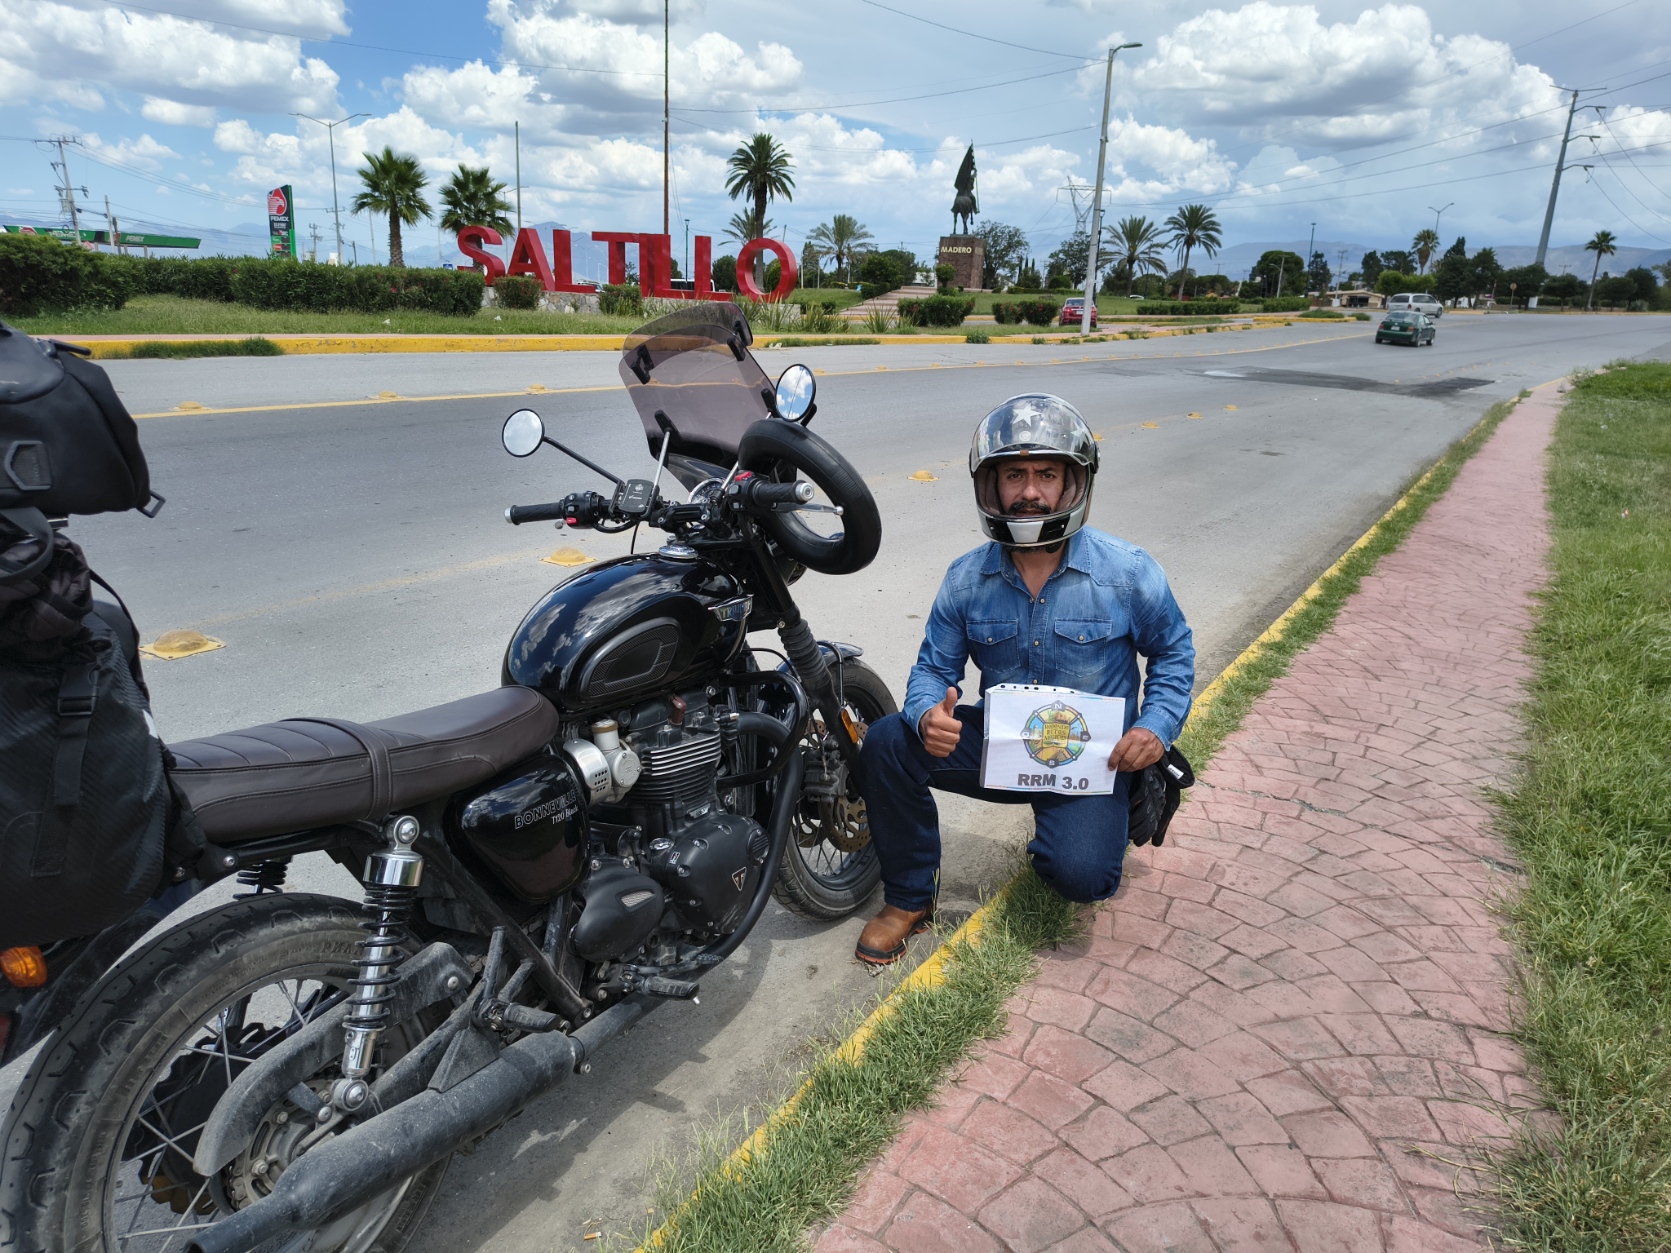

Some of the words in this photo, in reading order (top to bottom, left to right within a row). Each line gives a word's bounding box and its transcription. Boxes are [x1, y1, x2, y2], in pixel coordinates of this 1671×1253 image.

[49, 230, 86, 239] PEME
[125, 235, 145, 243] PEMEX
[940, 246, 972, 254] MADERO
[458, 225, 799, 302] SALTILLO
[1017, 773, 1057, 787] RRM
[1061, 776, 1090, 790] 3.0
[514, 789, 577, 830] BONNEVILLE
[551, 812, 565, 825] T120
[565, 804, 579, 818] Black
